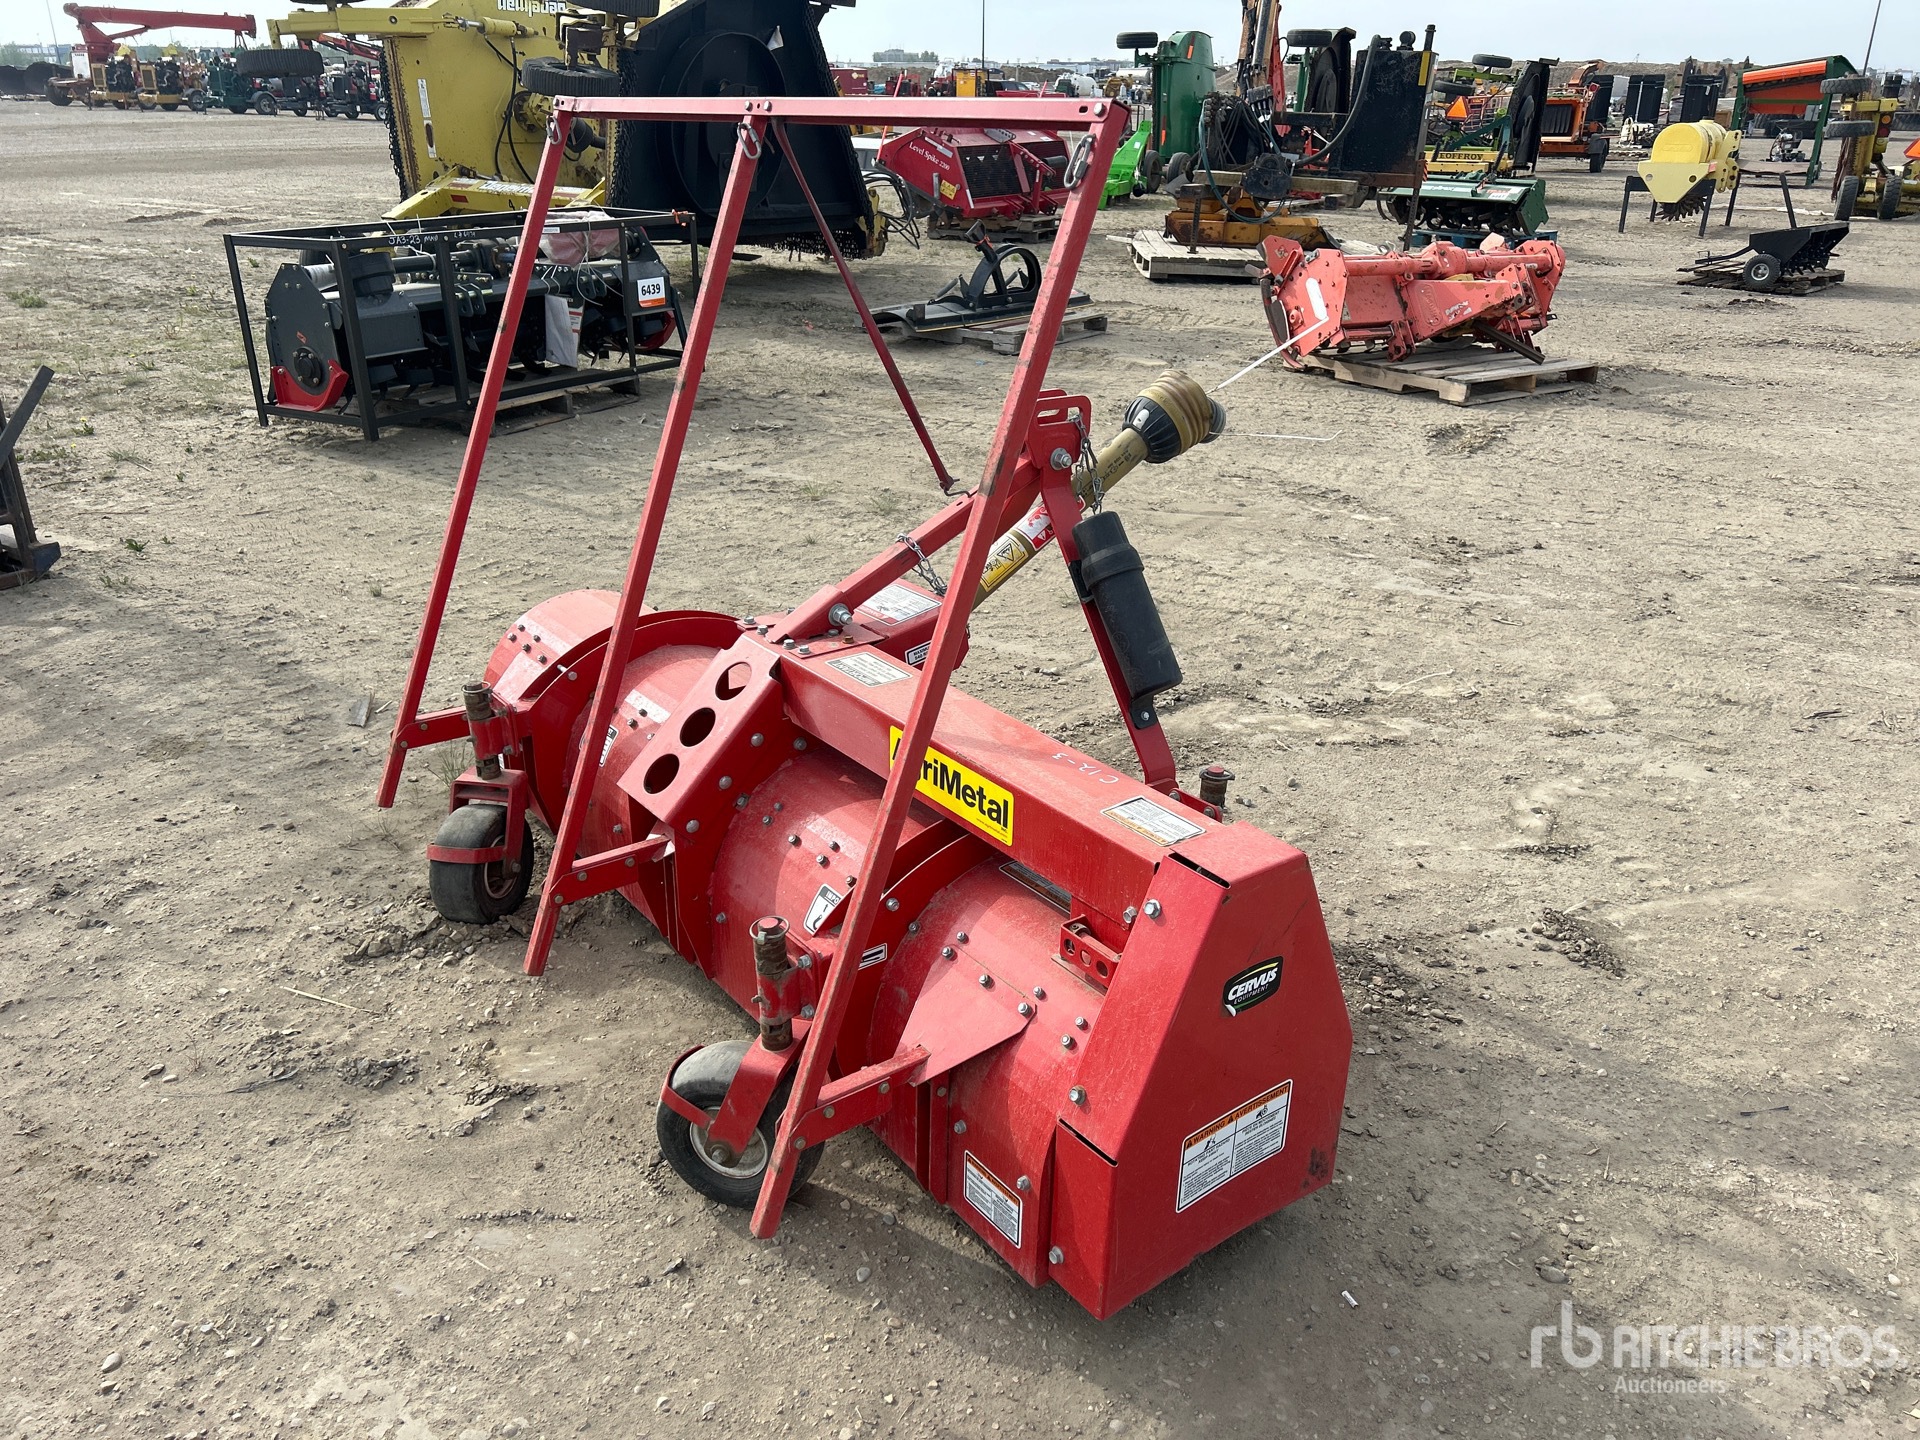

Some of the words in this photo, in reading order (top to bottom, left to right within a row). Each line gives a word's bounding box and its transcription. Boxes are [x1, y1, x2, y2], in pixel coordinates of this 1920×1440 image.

[909, 141, 925, 156] Level
[924, 150, 940, 165] Spike
[1439, 152, 1484, 161] EOFFROY
[641, 283, 661, 296] 6439
[892, 737, 1009, 829] riMetal
[1227, 967, 1278, 1001] CERVUS
[1233, 984, 1269, 1005] EQUIPMENT
[1193, 1120, 1226, 1143] WARNING
[1235, 1087, 1287, 1119] AVERTISSEMENT
